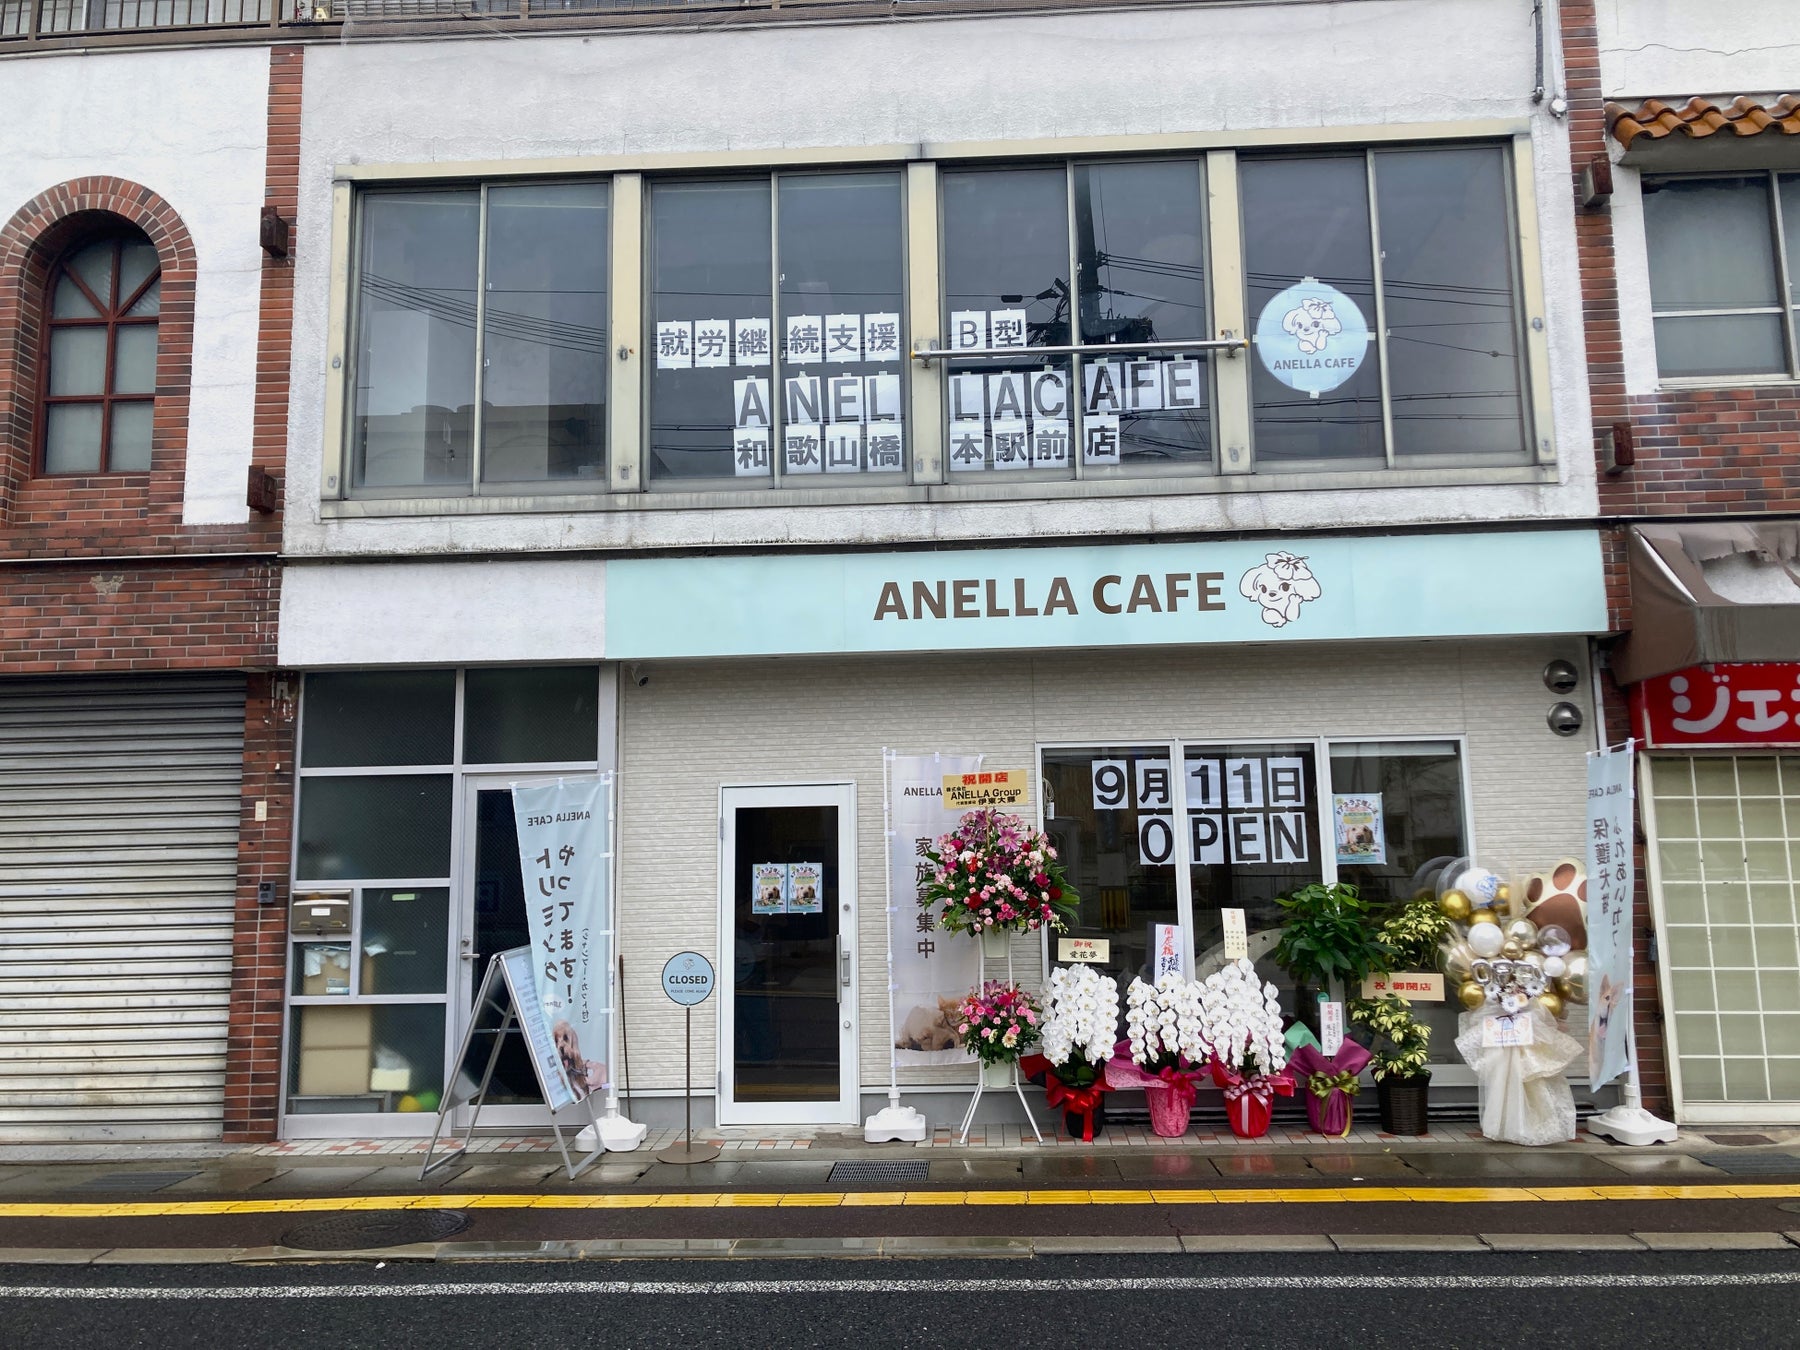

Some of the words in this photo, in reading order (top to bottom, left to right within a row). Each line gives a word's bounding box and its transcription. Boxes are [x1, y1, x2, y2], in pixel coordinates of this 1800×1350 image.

[1273, 359, 1321, 370] ANELLA
[1324, 358, 1355, 368] CAFE
[874, 577, 1079, 620] ANELLA
[1092, 572, 1226, 614] CAFE
[1670, 675, 1800, 733] ジェ
[962, 772, 1008, 785] 祝開店
[1094, 764, 1301, 805] 9月11日
[904, 787, 942, 796] ANELLA
[951, 790, 990, 800] ANELLA
[993, 788, 1021, 798] Group
[1141, 816, 1304, 864] OPEN
[669, 975, 708, 984] CLOSED
[1374, 982, 1386, 990] 祝
